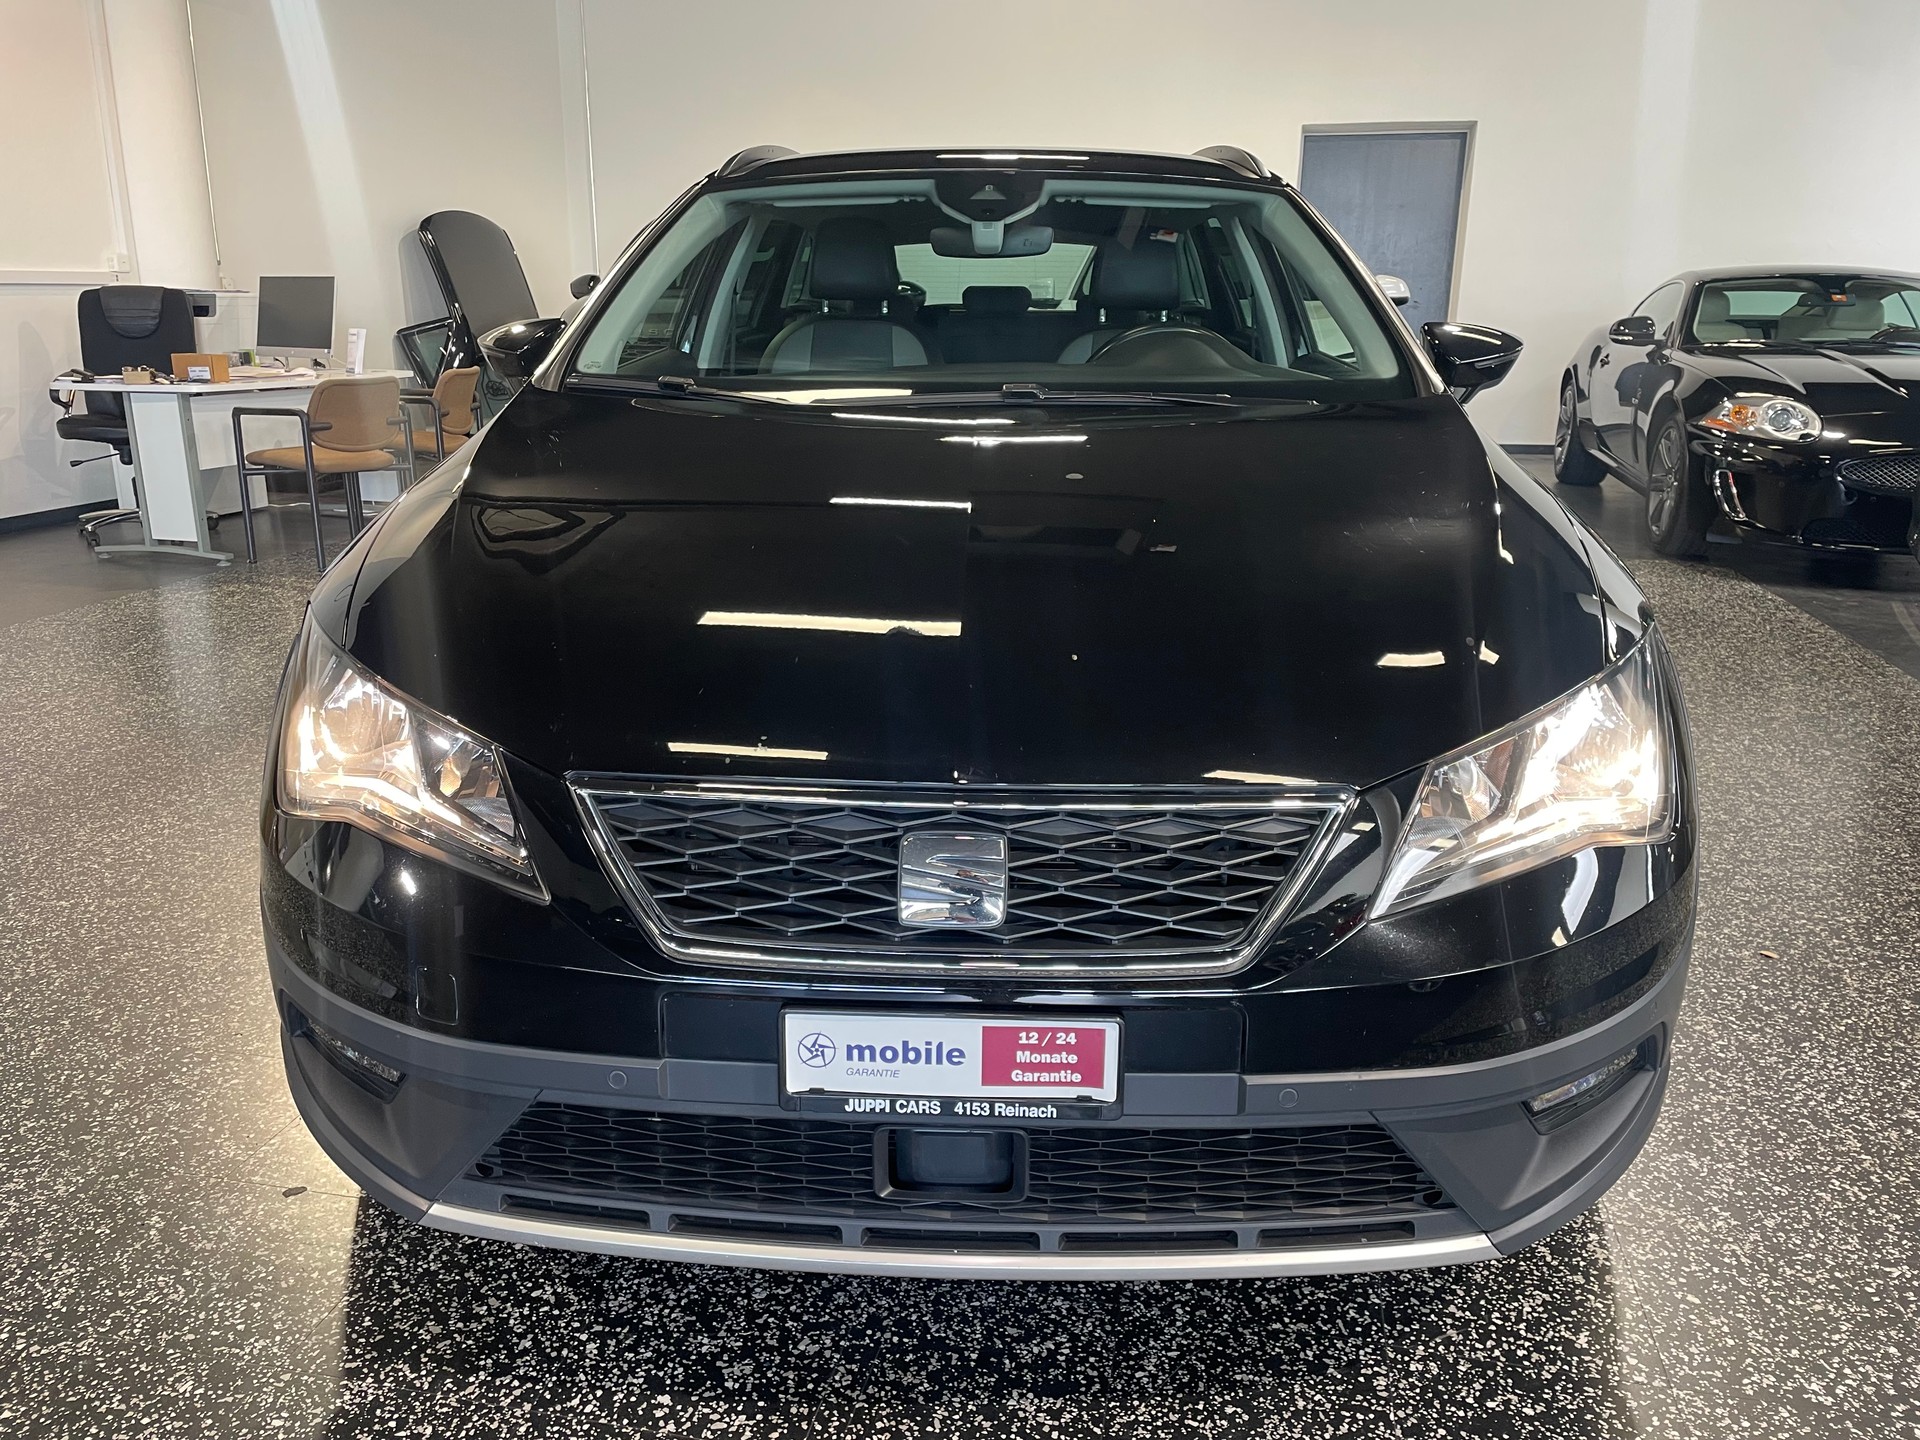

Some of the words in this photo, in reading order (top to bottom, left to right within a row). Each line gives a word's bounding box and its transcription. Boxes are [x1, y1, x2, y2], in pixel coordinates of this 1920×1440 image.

[1018, 1032, 1039, 1044] 12
[1056, 1033, 1077, 1045] 24
[846, 1040, 966, 1066] mobile
[1016, 1051, 1078, 1064] Monate
[846, 1067, 900, 1079] GARANTIE
[1011, 1070, 1082, 1083] Garantie
[845, 1098, 890, 1113] JUPPI
[895, 1100, 941, 1115] CARS
[954, 1103, 990, 1117] 4153
[994, 1104, 1057, 1119] Reinach
